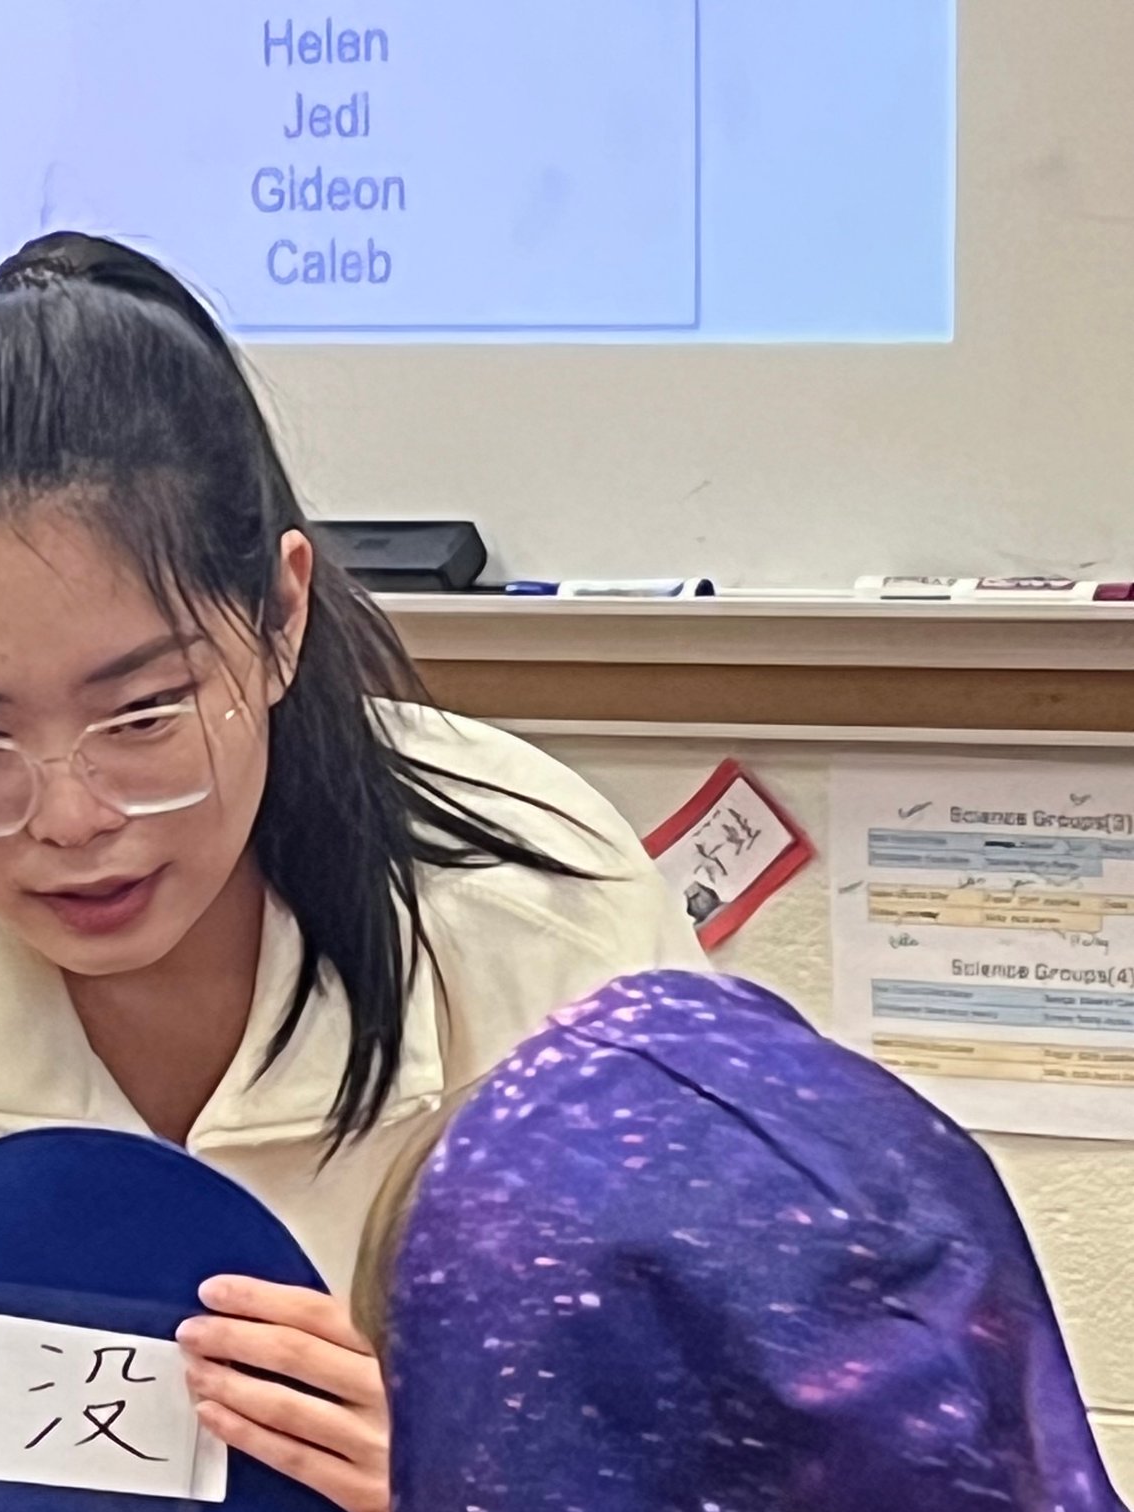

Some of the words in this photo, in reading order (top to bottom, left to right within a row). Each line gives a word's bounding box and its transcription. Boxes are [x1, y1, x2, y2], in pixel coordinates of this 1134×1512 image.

[264, 17, 388, 66] Helen
[251, 164, 406, 213] Gideon
[267, 237, 392, 285] Caleb
[25, 1343, 169, 1462] 没
